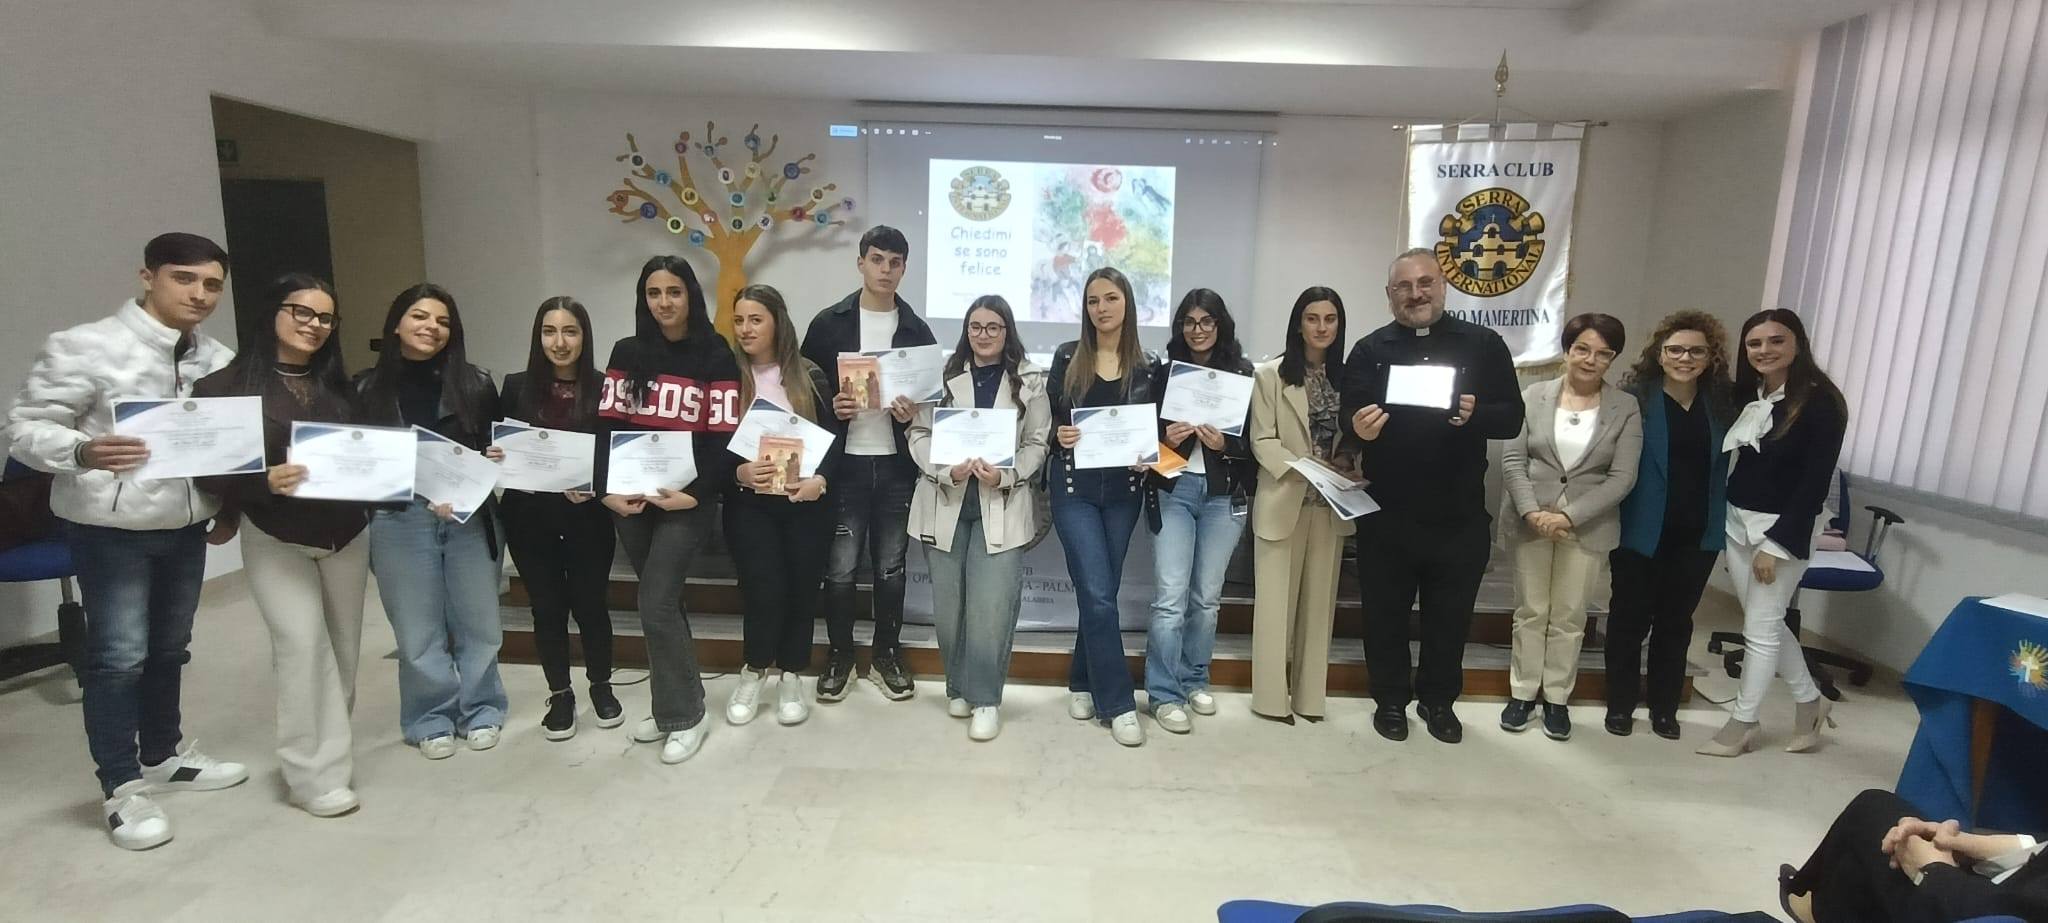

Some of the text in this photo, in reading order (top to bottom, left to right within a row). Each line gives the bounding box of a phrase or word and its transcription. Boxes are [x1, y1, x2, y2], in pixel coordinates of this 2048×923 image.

[1437, 162, 1554, 178] SERRA CLUB
[1462, 191, 1522, 215] SERRA
[951, 226, 1012, 240] Chiedimi
[954, 246, 1008, 258] se sono
[960, 261, 1001, 275] felice
[1437, 247, 1542, 294] INTERNATIONAL
[1471, 309, 1550, 327] MAMERTINA
